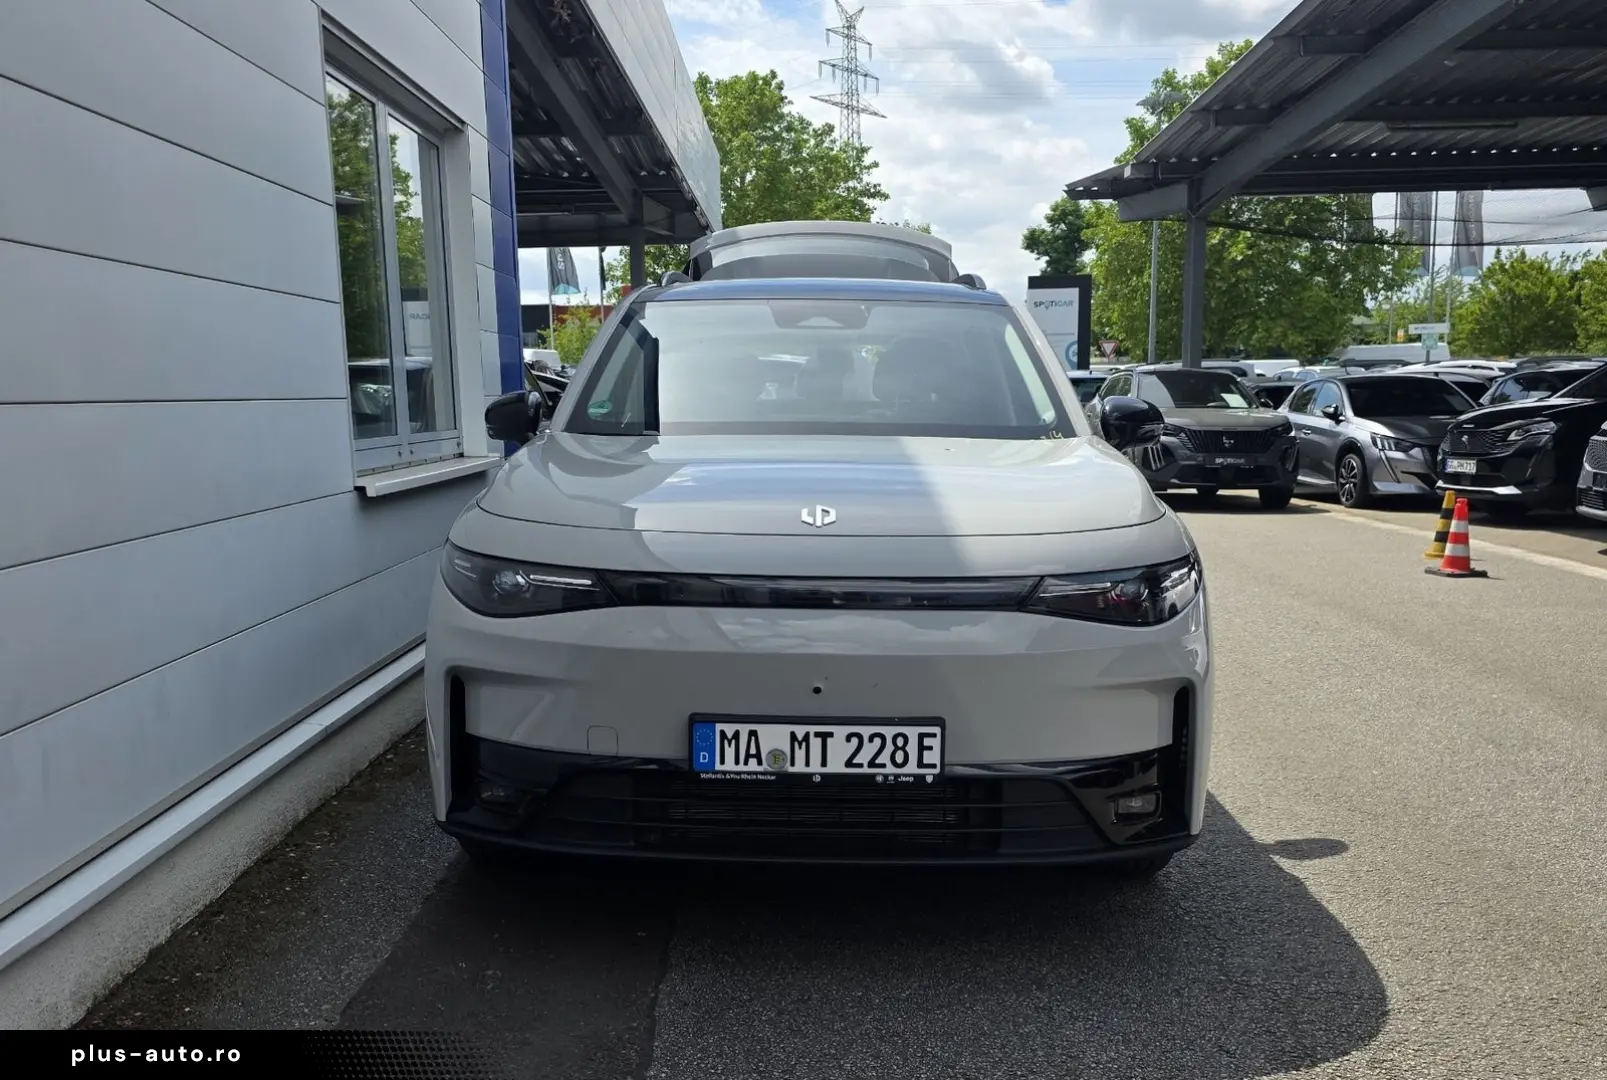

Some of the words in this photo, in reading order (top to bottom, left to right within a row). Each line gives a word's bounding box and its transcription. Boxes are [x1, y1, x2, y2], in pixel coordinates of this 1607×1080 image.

[1033, 300, 1074, 310] SPOTICAR
[699, 752, 709, 763] D
[719, 729, 763, 766] MA
[790, 731, 834, 768] MT
[844, 732, 938, 769] 228E
